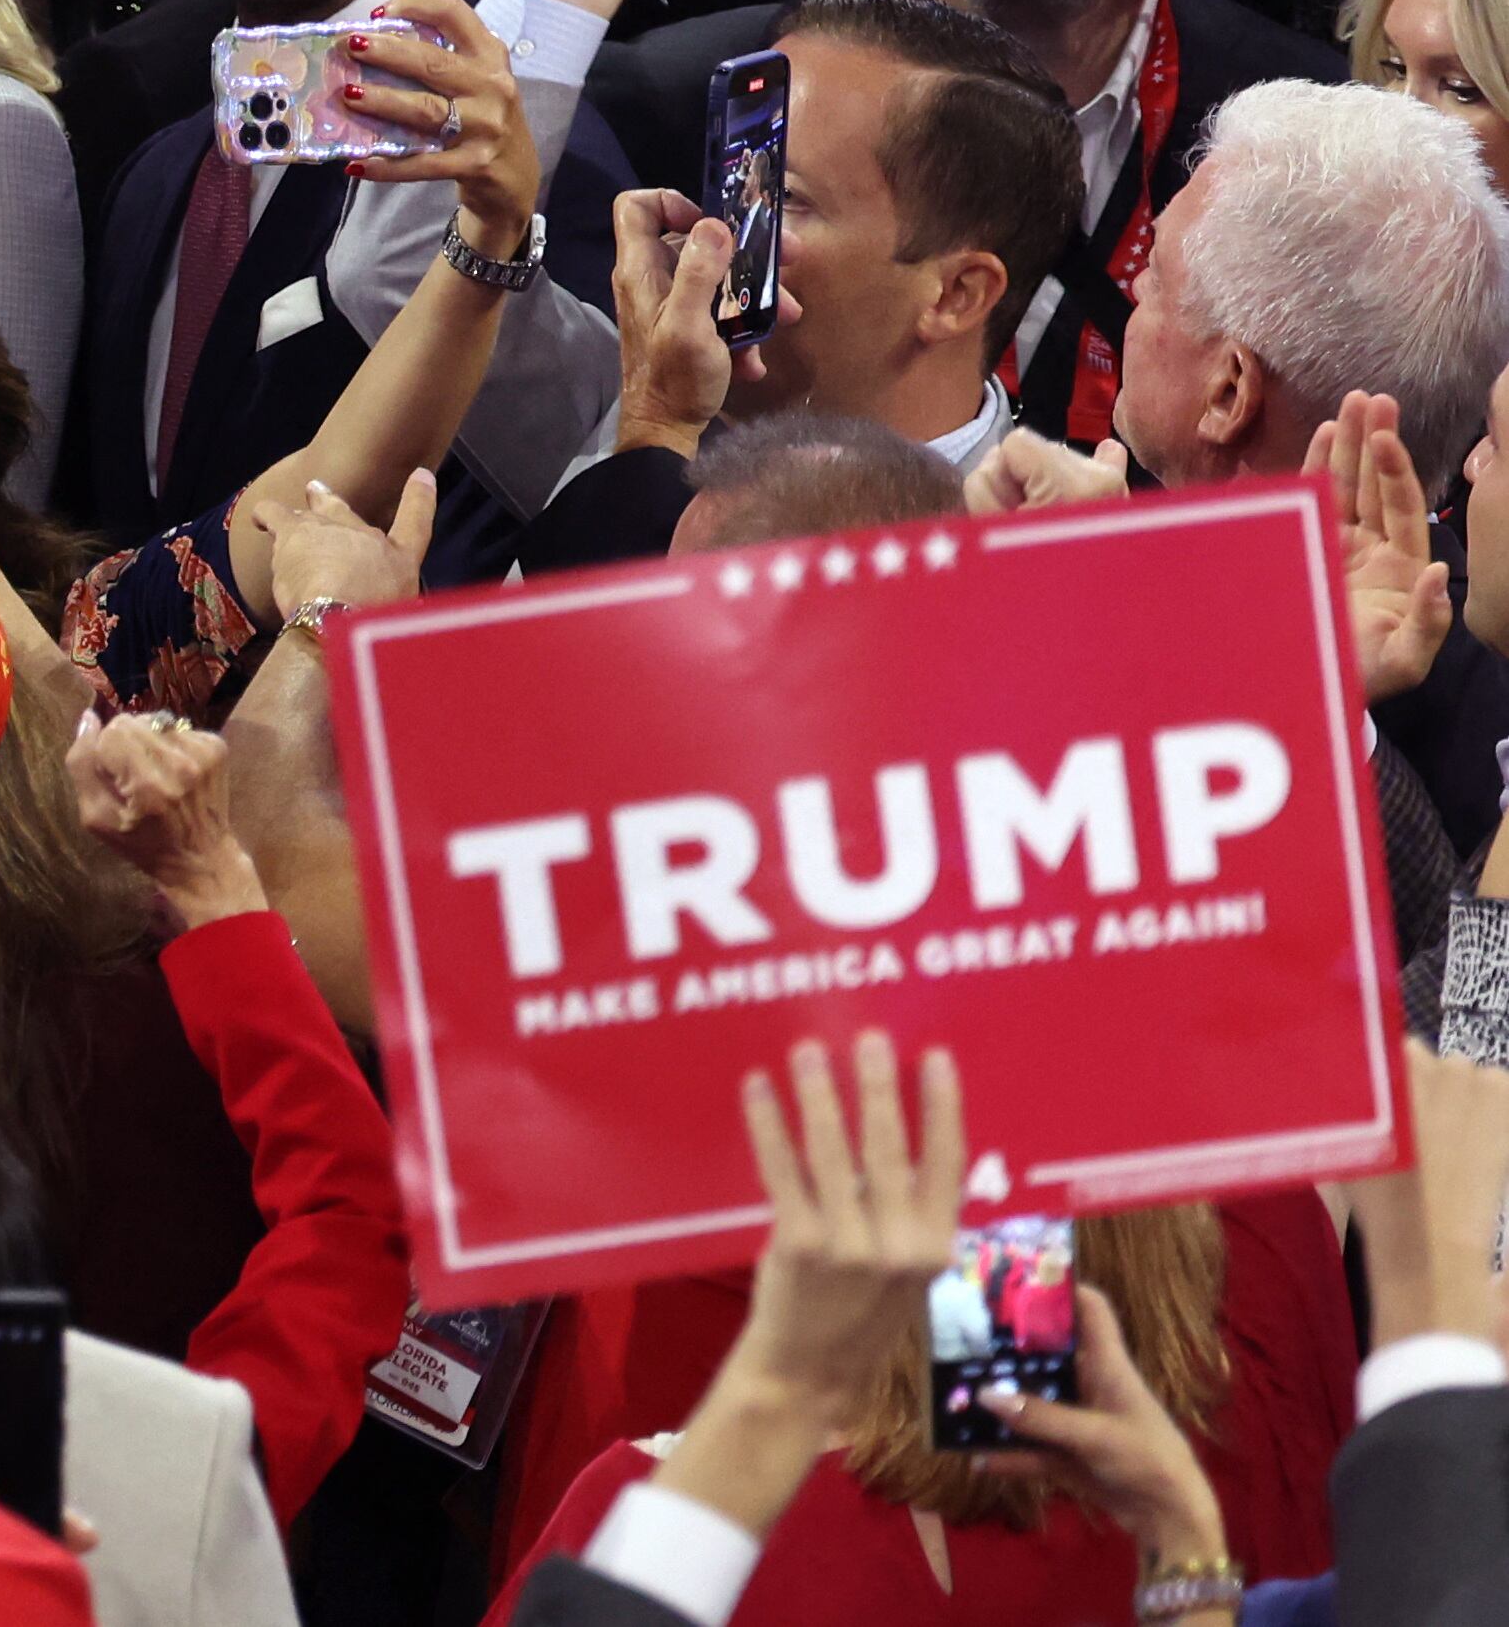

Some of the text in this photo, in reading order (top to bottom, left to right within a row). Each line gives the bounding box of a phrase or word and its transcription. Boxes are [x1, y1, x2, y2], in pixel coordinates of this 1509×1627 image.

[446, 722, 1291, 976] TRUMP
[515, 893, 1266, 1034] MAKE AMERICA GREAT AGAIN!
[386, 1354, 449, 1393] LEGATE
[399, 1342, 447, 1377] ORIDA
